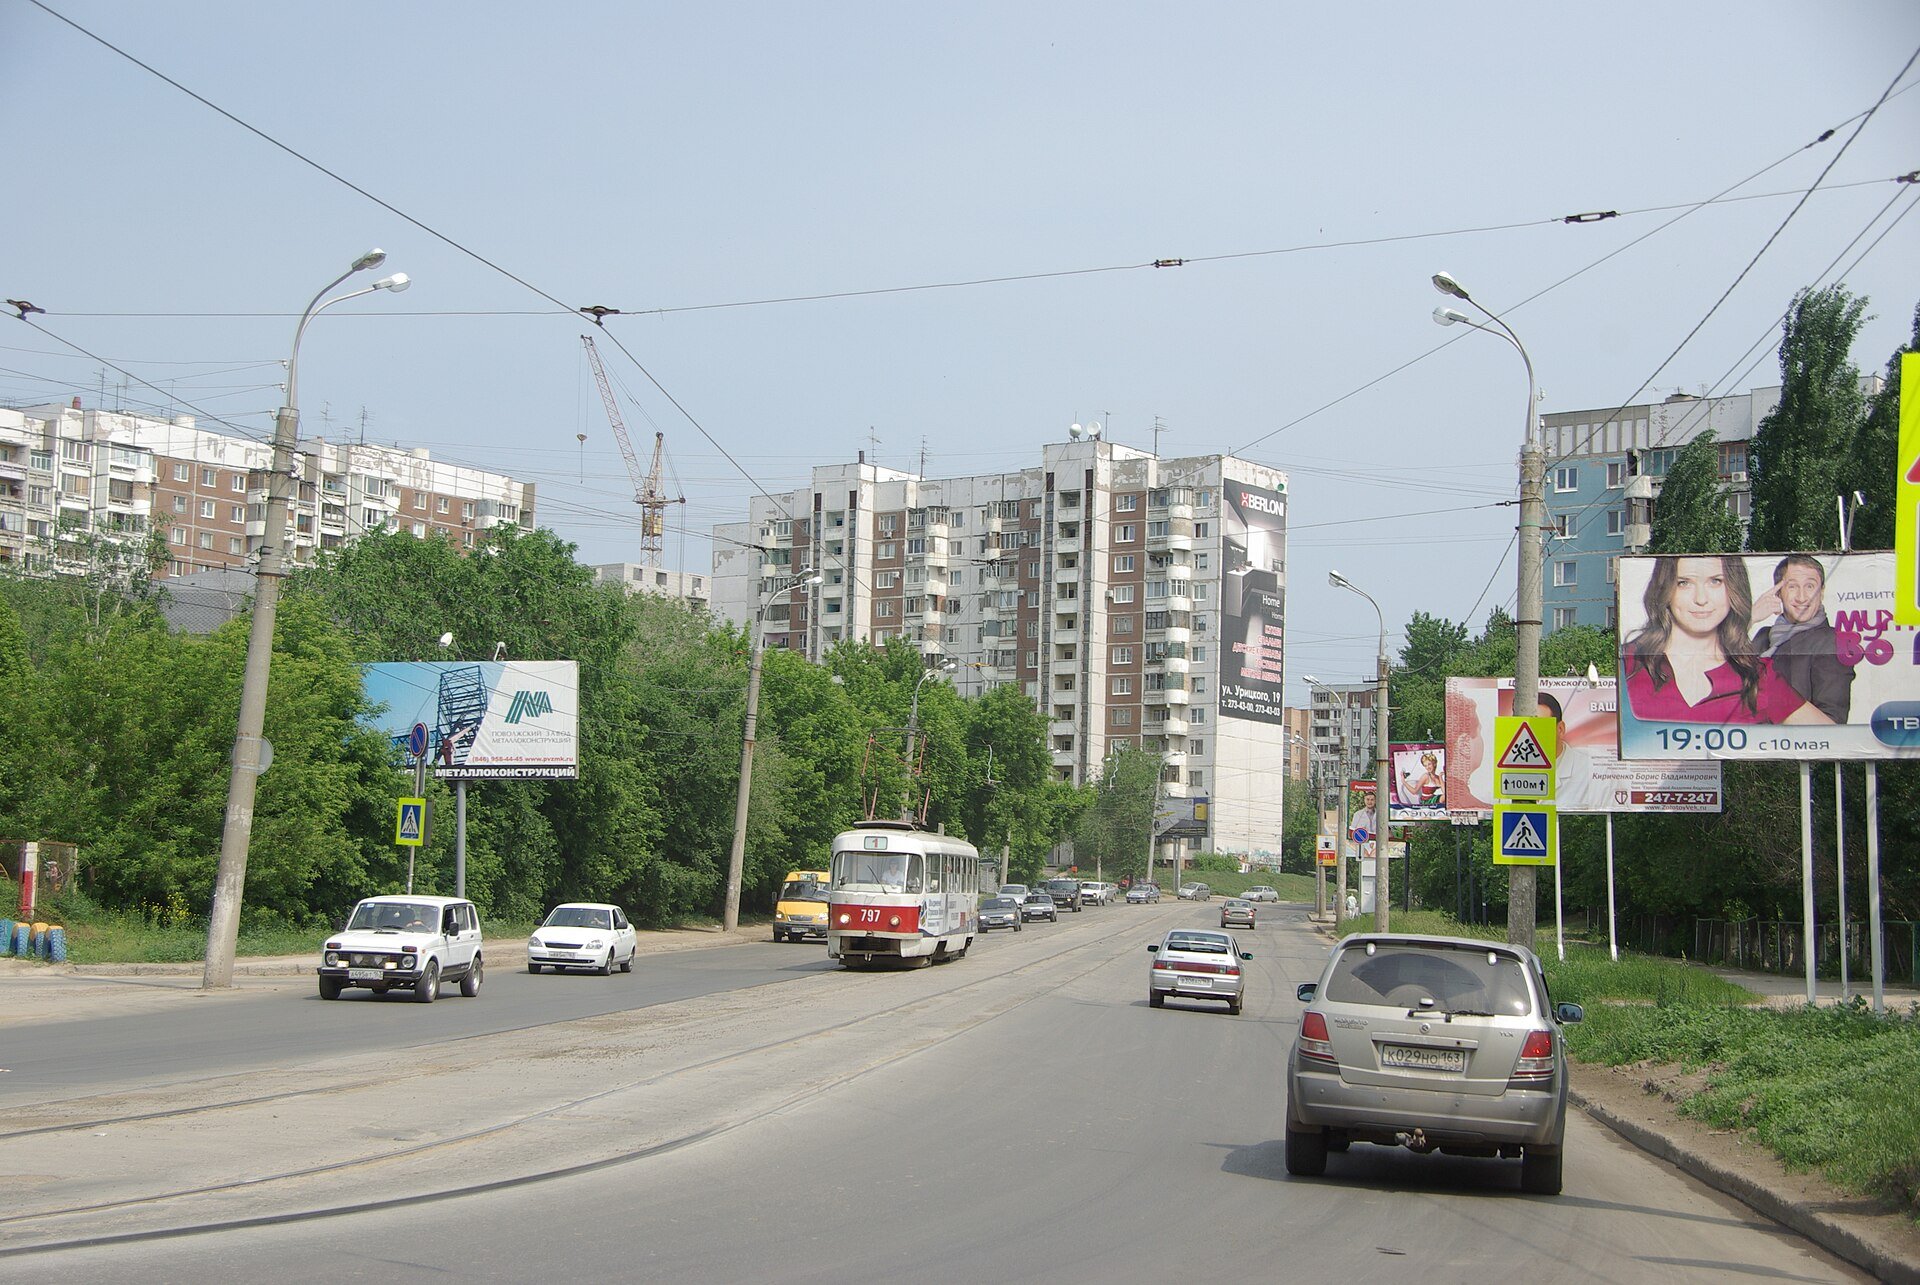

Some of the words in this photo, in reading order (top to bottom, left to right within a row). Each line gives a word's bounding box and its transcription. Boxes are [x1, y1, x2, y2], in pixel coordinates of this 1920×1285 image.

[1248, 493, 1285, 517] BERLONI
[1262, 594, 1281, 608] Home
[1539, 679, 1588, 688] Мужского
[1222, 685, 1233, 696] ул.
[1235, 685, 1271, 703] Урицкого,
[1272, 691, 1281, 704] 19
[1656, 728, 1748, 751] 19:00
[1770, 739, 1791, 751] 10
[1794, 739, 1830, 751] мая
[435, 766, 576, 777] МЕТАЛЛОКОНСТРУКЦИЙ
[1592, 773, 1634, 781] Кириченко
[1635, 772, 1659, 780] Борис
[1661, 773, 1718, 781] Владимирович
[1511, 779, 1537, 789] 100м
[1644, 793, 1714, 803] 247-7-247
[872, 838, 879, 848] 1
[860, 909, 881, 922] 797
[1441, 1052, 1460, 1063] 163
